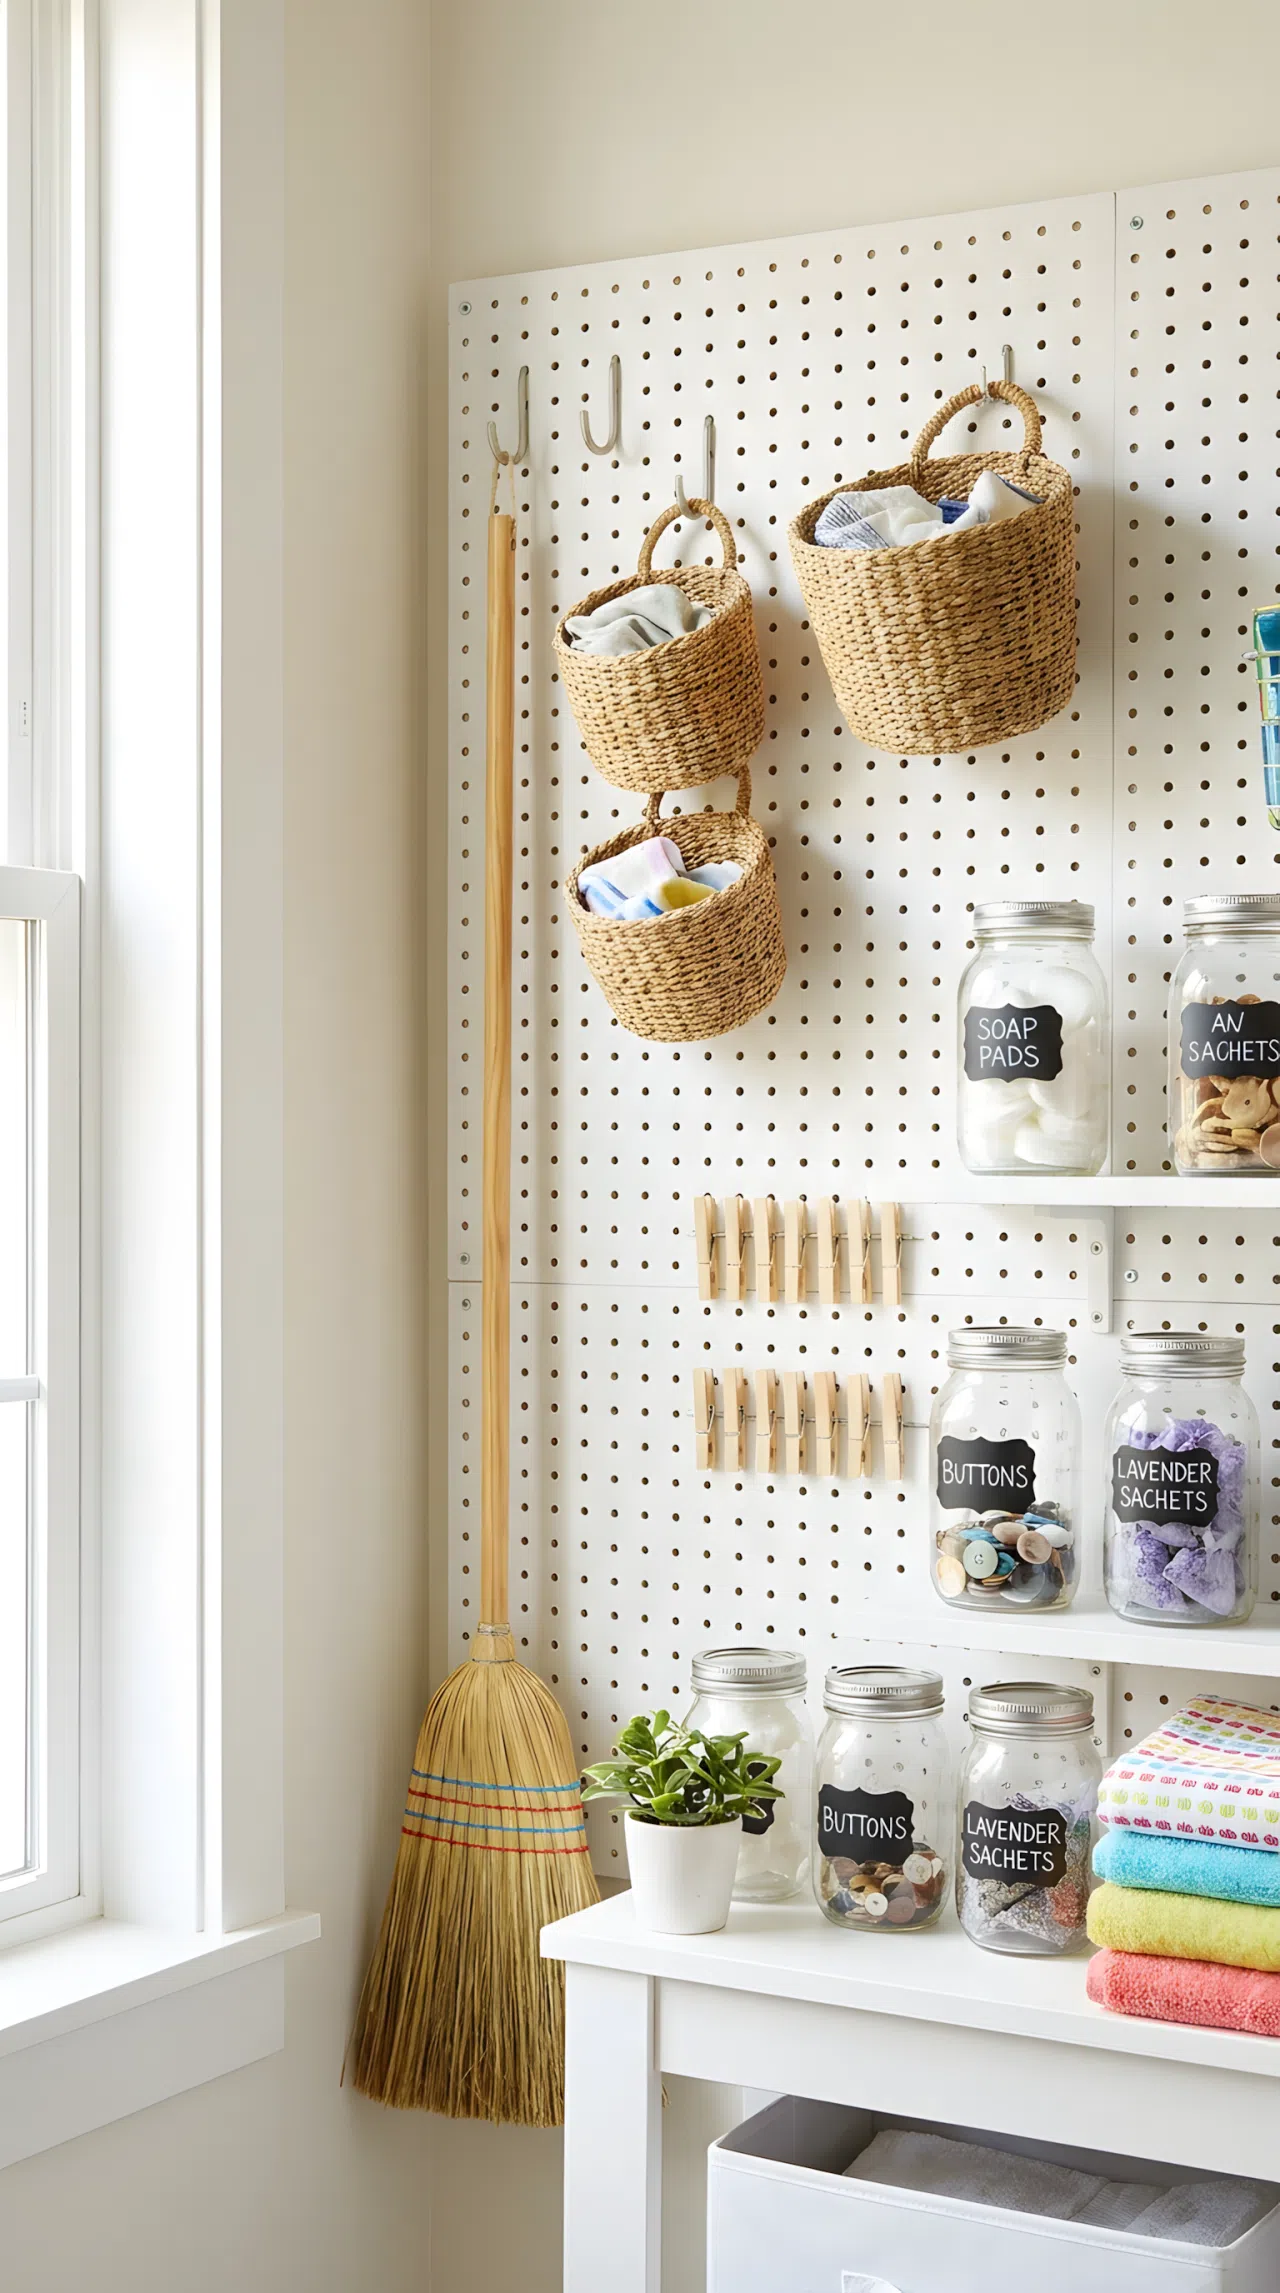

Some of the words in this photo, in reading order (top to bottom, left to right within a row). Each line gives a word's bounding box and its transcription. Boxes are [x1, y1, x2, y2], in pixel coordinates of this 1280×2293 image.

[977, 1017, 1038, 1040] SOAP
[980, 1045, 1039, 1068] PADS
[1189, 1039, 1280, 1062] SACHETS
[942, 1458, 1029, 1488] BUTTONS
[1117, 1458, 1212, 1484] LAVENDER
[1120, 1486, 1207, 1512] SACHETS
[823, 1806, 906, 1839] BUTTONS
[966, 1812, 1061, 1844] LAVENDER
[969, 1842, 1054, 1872] SACHETS
